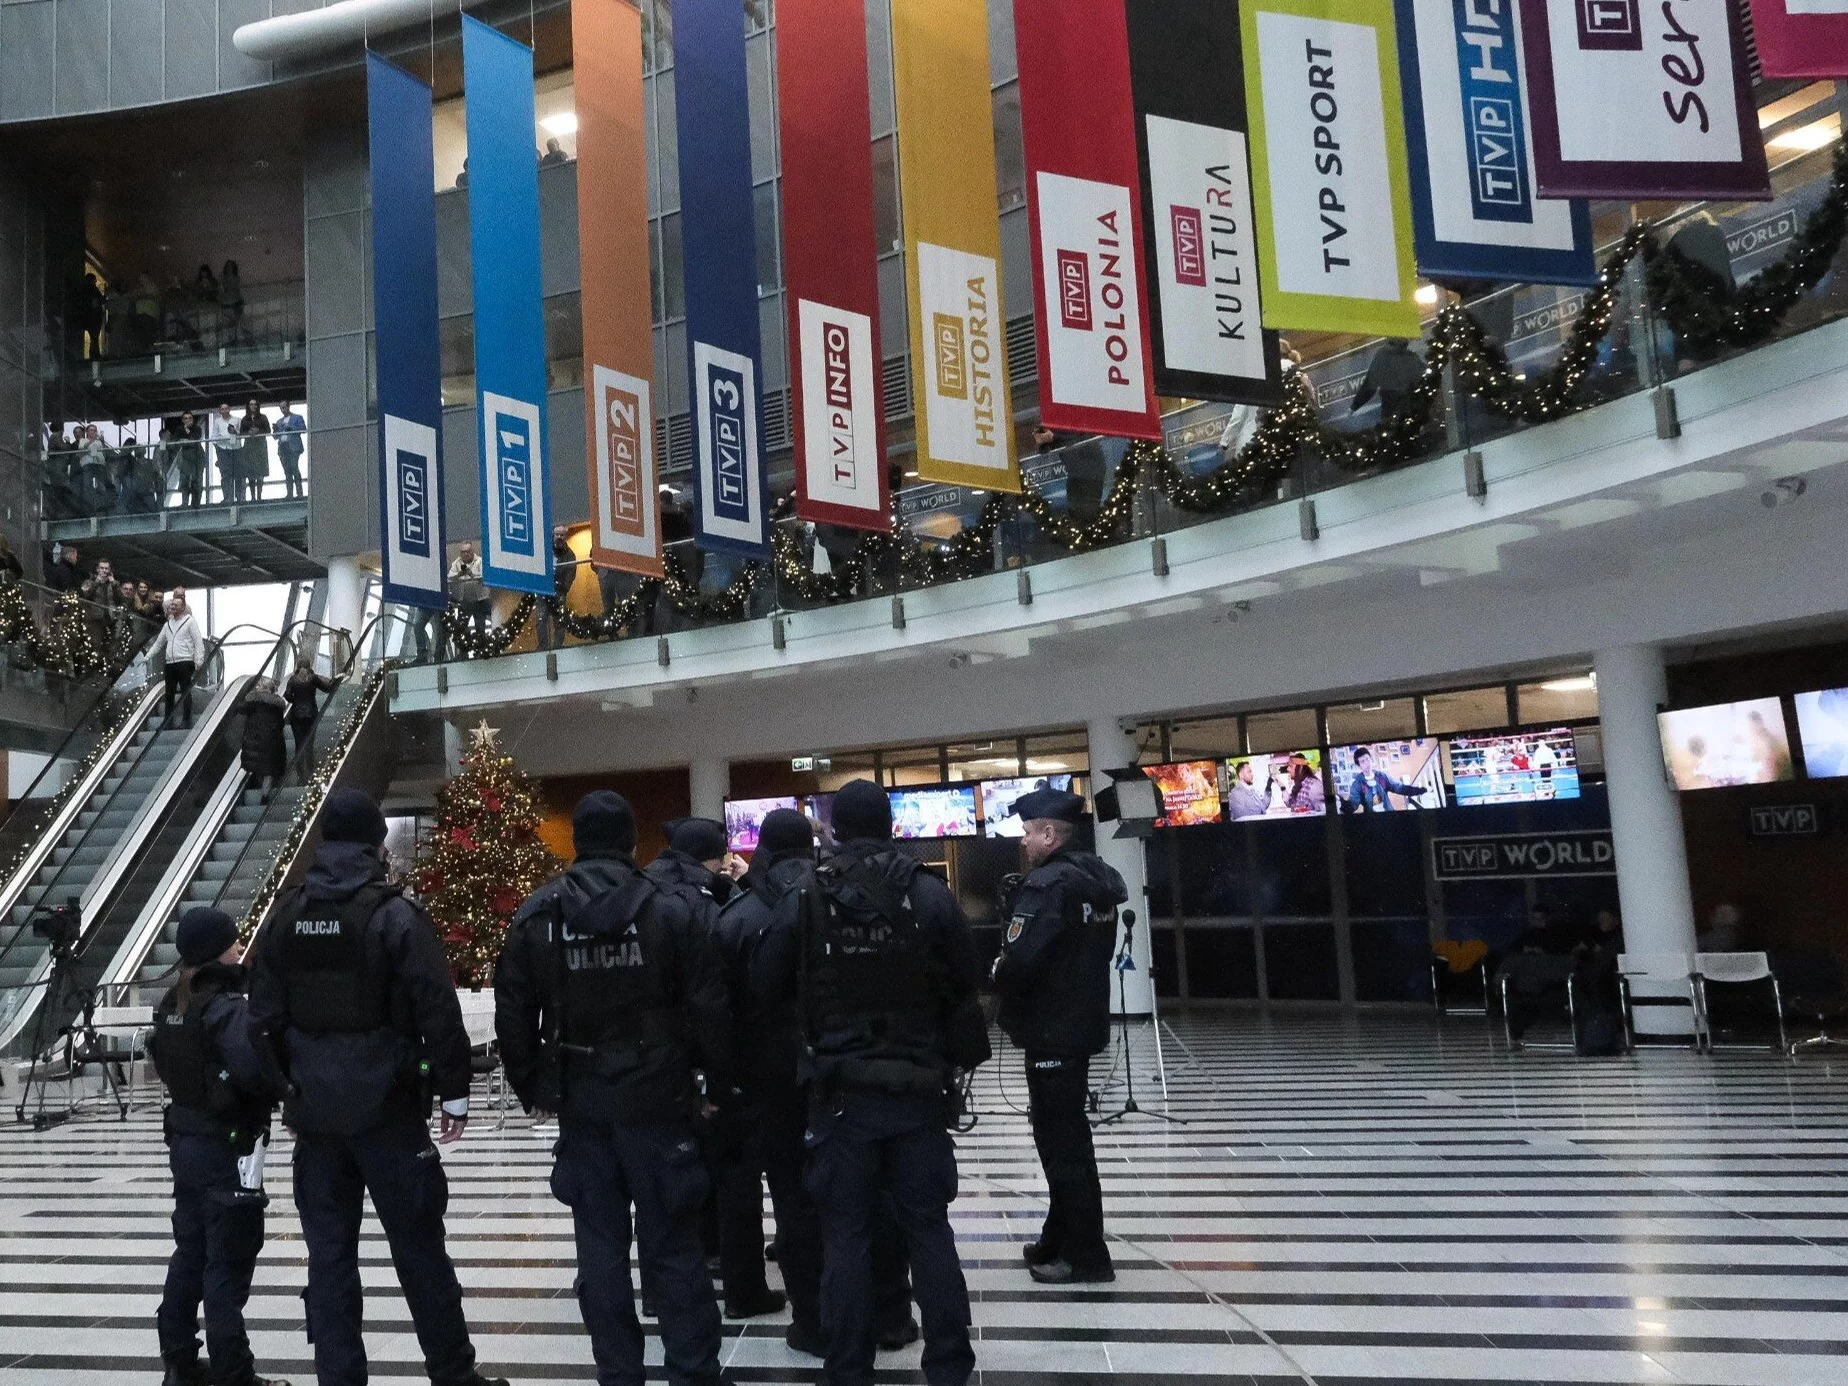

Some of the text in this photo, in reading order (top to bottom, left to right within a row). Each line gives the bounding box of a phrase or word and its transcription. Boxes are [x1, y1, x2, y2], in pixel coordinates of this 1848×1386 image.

[1305, 39, 1350, 273] TVP SPORT
[1479, 106, 1512, 199] TVP
[1178, 221, 1198, 272] TVP
[1204, 164, 1245, 341] KULTURA
[1726, 219, 1790, 254] WORLD
[1063, 261, 1087, 322] TVP
[1097, 209, 1130, 387] POLONIA
[1524, 301, 1578, 330] WORLD
[939, 324, 963, 391] TVP
[967, 275, 996, 448] HISTORIA
[824, 329, 853, 483] TVP INFO
[615, 440, 637, 519] TVP
[720, 422, 742, 501] TVP
[404, 470, 422, 541] TVP
[506, 465, 526, 539] TVP
[921, 492, 957, 508] WORLD
[1445, 840, 1612, 871] TVP WORLD
[1755, 809, 1812, 831] TVP
[295, 921, 340, 935] POLICJA
